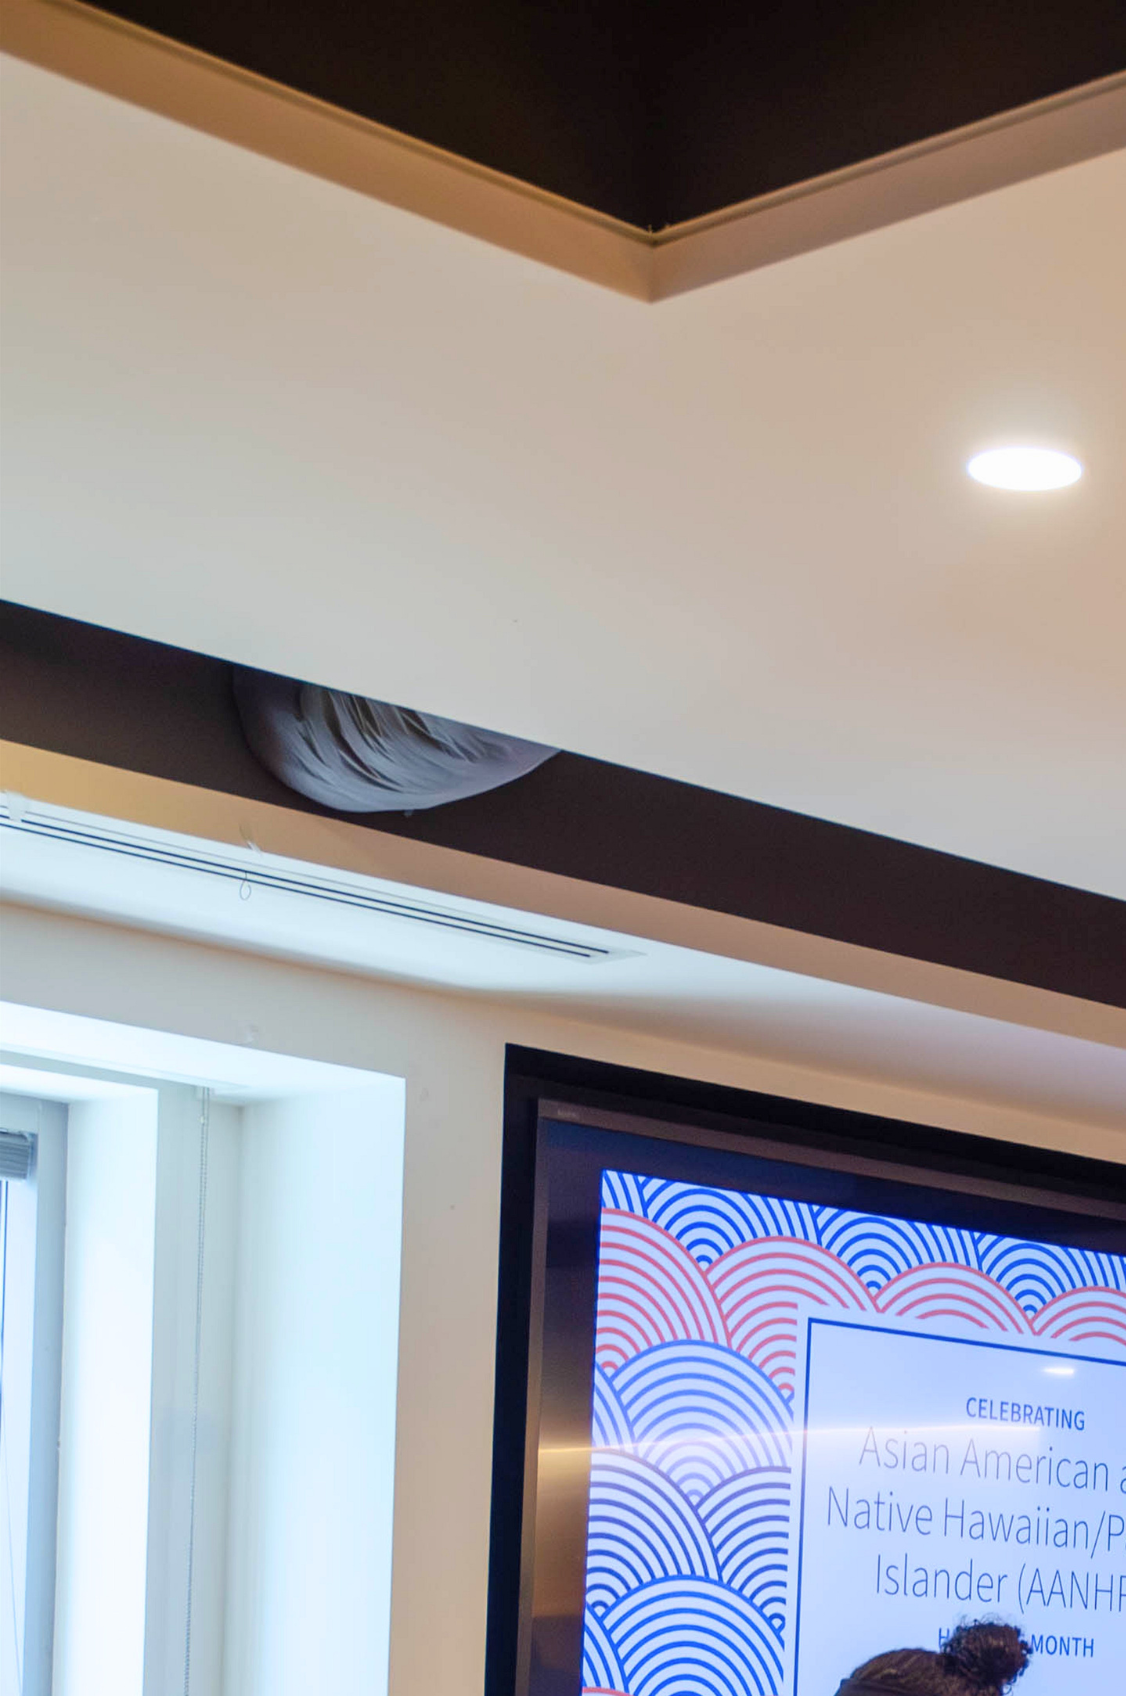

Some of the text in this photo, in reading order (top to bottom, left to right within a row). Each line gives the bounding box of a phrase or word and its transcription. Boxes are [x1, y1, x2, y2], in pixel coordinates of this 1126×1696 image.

[966, 1397, 1086, 1431] CELEBRATING
[858, 1425, 950, 1474] Asian
[960, 1437, 1109, 1491] American
[827, 1485, 933, 1536] Native
[875, 1552, 1008, 1603] Islander
[1031, 1634, 1095, 1658] MONTH
